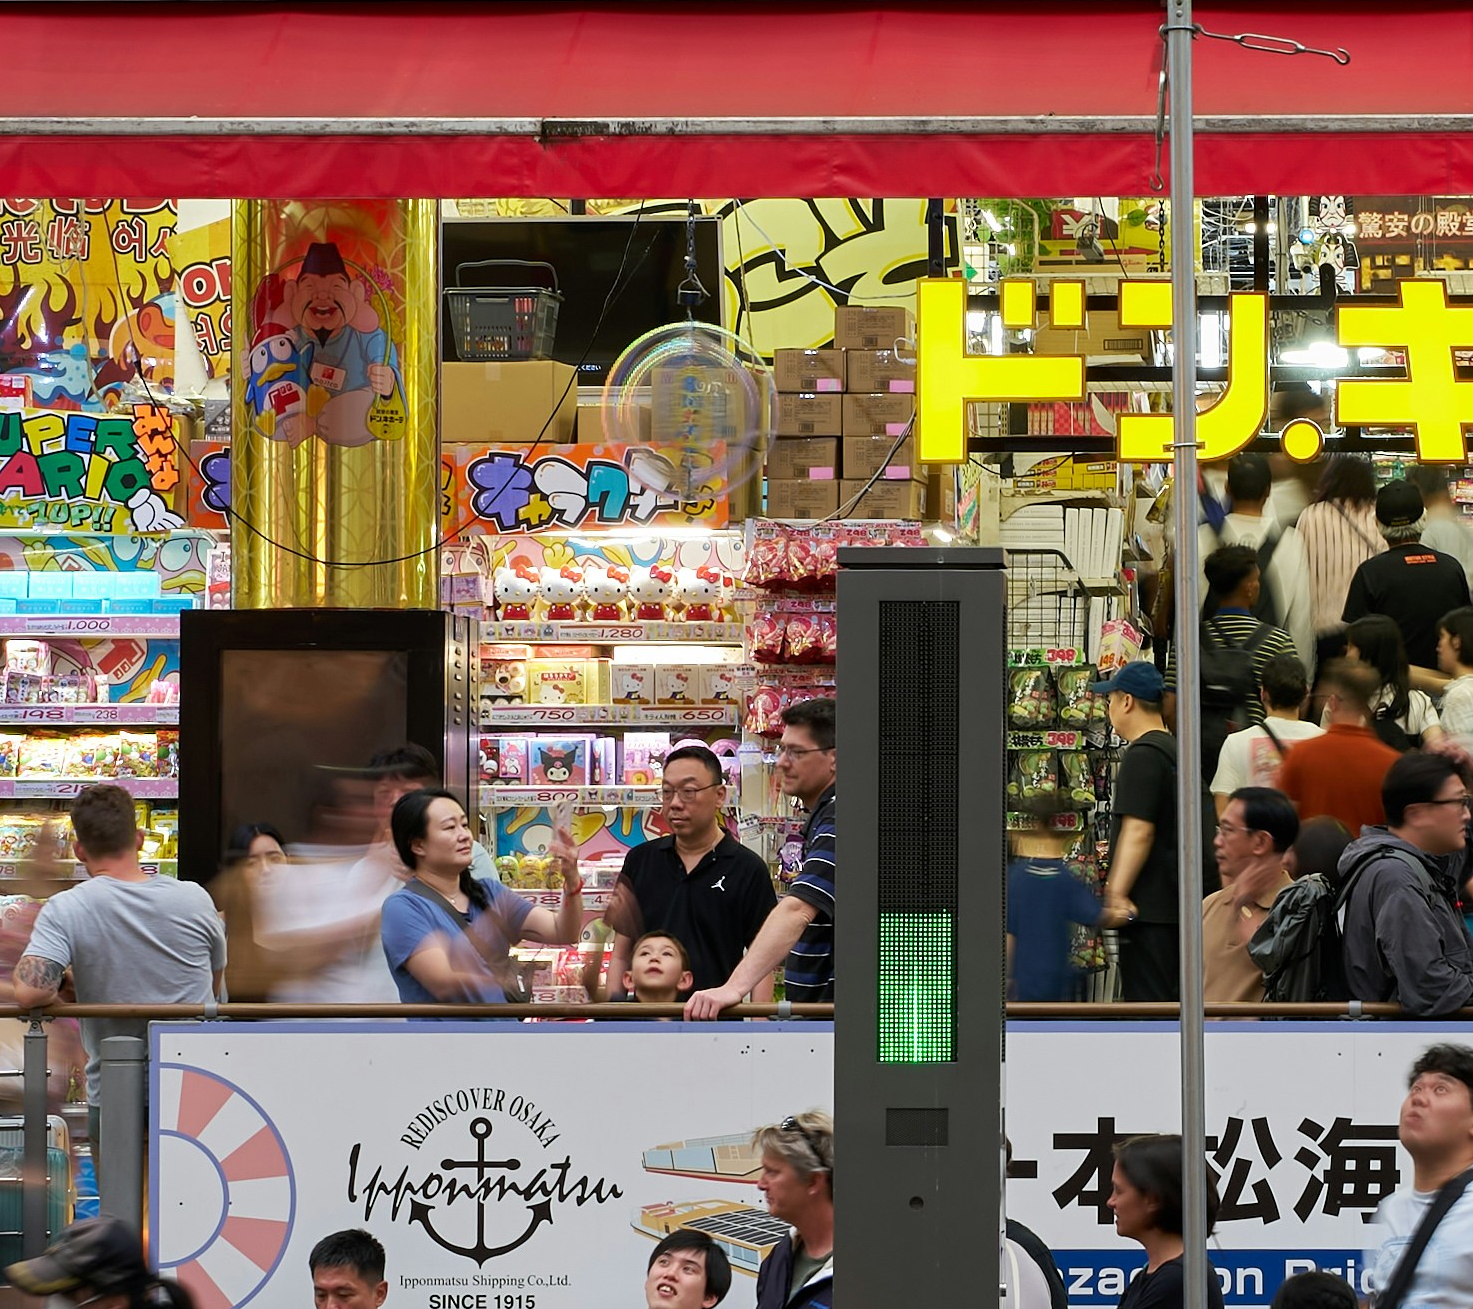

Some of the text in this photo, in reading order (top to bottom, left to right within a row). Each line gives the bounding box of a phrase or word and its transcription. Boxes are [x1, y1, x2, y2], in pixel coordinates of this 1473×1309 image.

[400, 1088, 561, 1151] REDISCOVER OSAKA
[347, 1143, 624, 1222] Ipponmatsu
[399, 1275, 572, 1289] Ipponmatsu Shipping Co.,Ltd.
[429, 1294, 536, 1309] SINCE 1915
